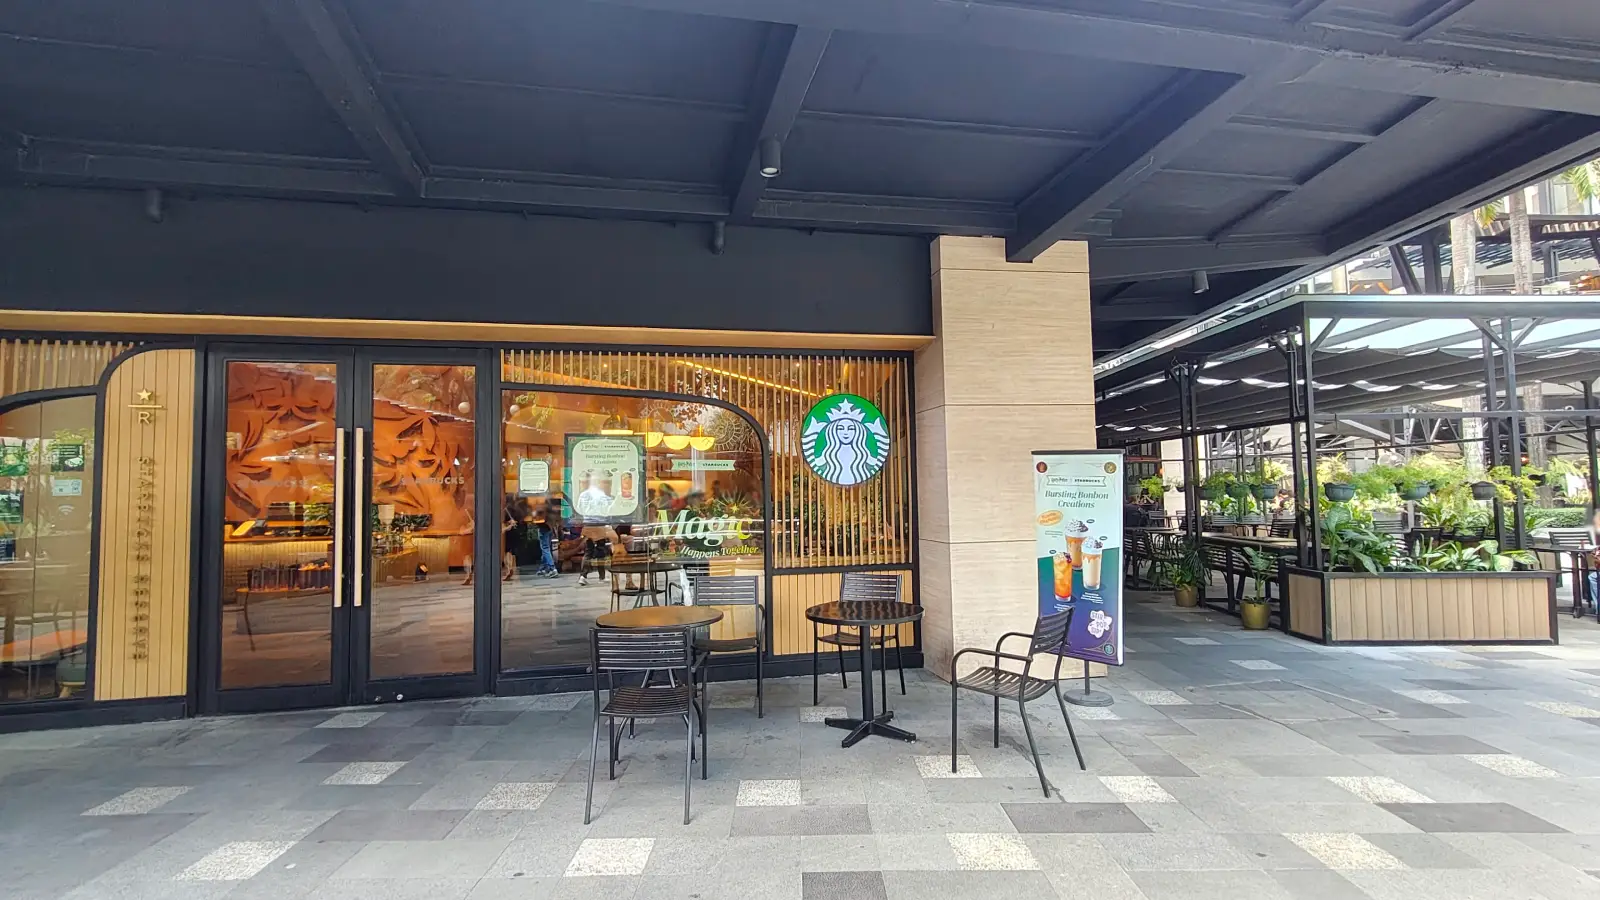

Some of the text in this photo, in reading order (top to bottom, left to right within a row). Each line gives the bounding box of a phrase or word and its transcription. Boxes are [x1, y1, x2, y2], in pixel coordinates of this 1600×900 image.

[138, 411, 150, 425] R
[401, 476, 465, 485] SBUCKS
[1045, 490, 1109, 499] Bursting Bonbon
[136, 456, 152, 563] STARBUCKS
[1058, 500, 1095, 508] Creations
[653, 509, 753, 546] Magic
[680, 544, 759, 559] Happens Together
[132, 574, 149, 661] RESERVE
